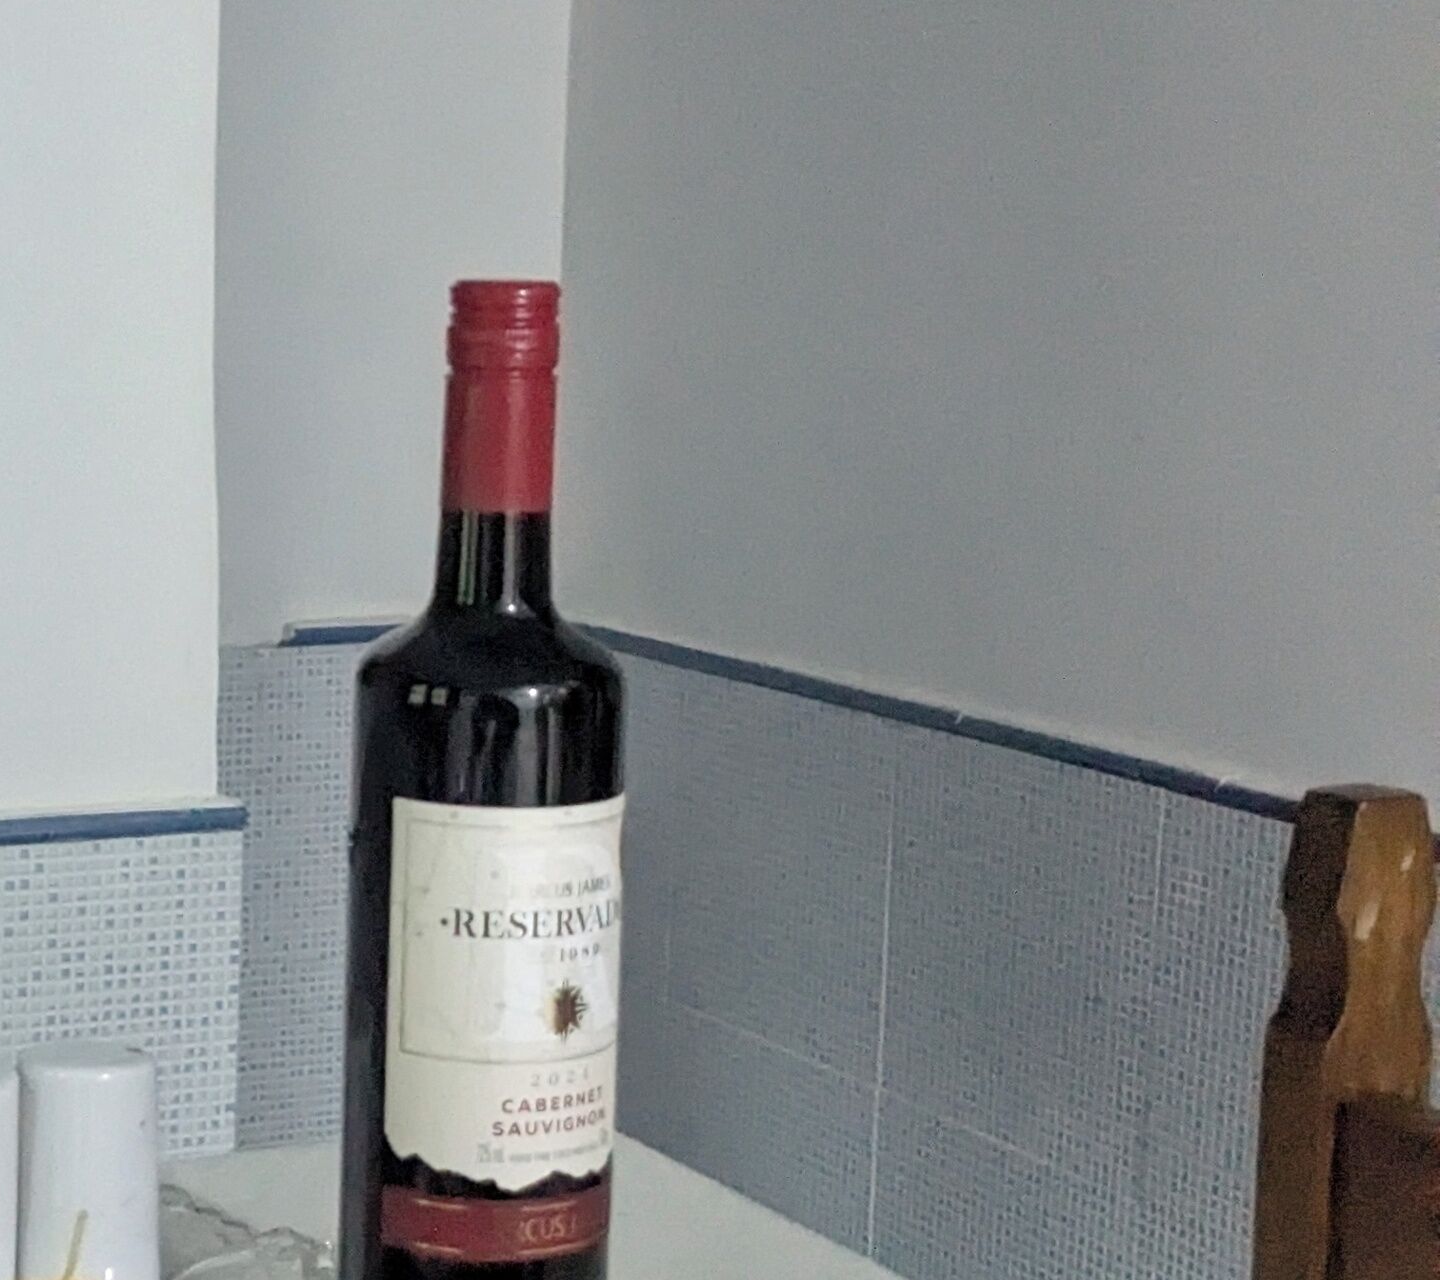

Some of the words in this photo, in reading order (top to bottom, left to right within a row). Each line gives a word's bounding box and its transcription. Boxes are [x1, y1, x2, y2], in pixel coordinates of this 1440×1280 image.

[452, 900, 621, 940] RESERVAD
[501, 1085, 603, 1114] CABERNET
[491, 1107, 606, 1137] SAUVIGNON
